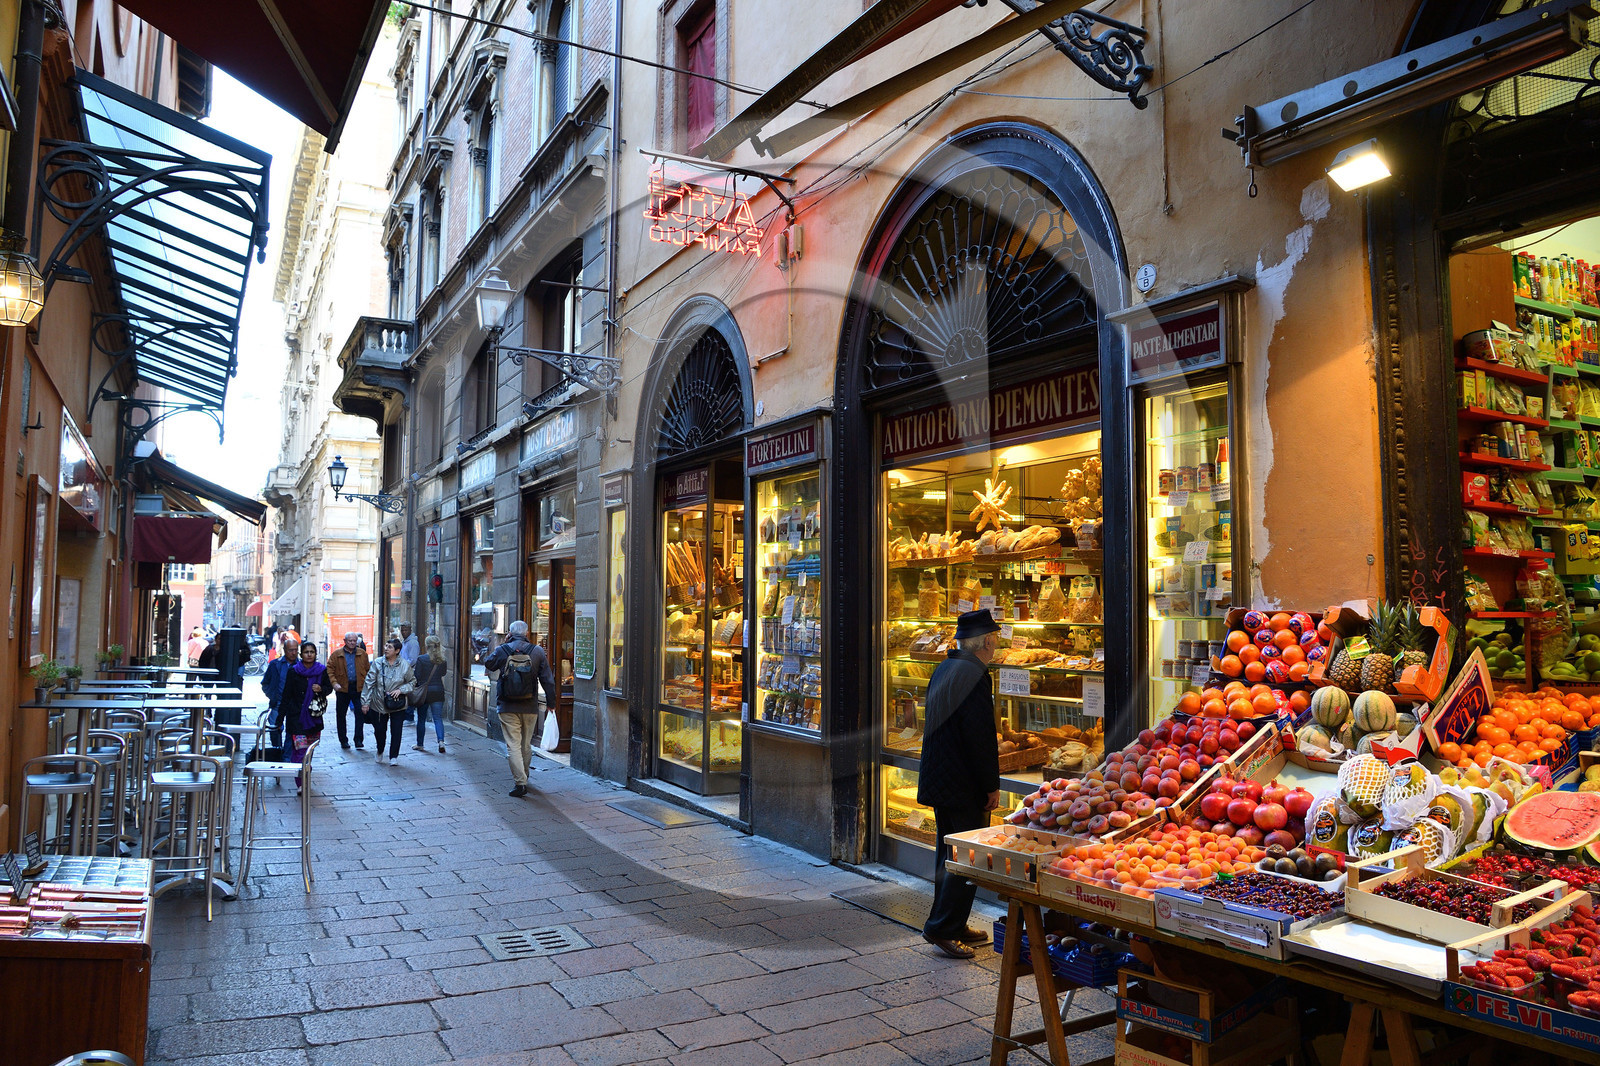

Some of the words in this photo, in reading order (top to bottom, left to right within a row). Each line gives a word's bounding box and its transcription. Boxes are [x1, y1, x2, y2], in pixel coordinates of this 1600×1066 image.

[1143, 278, 1149, 288] B
[1132, 335, 1162, 360] PASTE
[1162, 320, 1218, 352] ALIMENTARI
[526, 412, 574, 456] ROSTICCERIA
[884, 410, 936, 455] ANTICO
[937, 396, 990, 443] FORNO
[750, 429, 810, 465] TORTELLINI
[664, 480, 683, 497] Paolo
[1120, 999, 1162, 1021] FE.VI.
[1477, 994, 1562, 1035] FE.VI.
[1563, 1028, 1600, 1045] FRUTT
